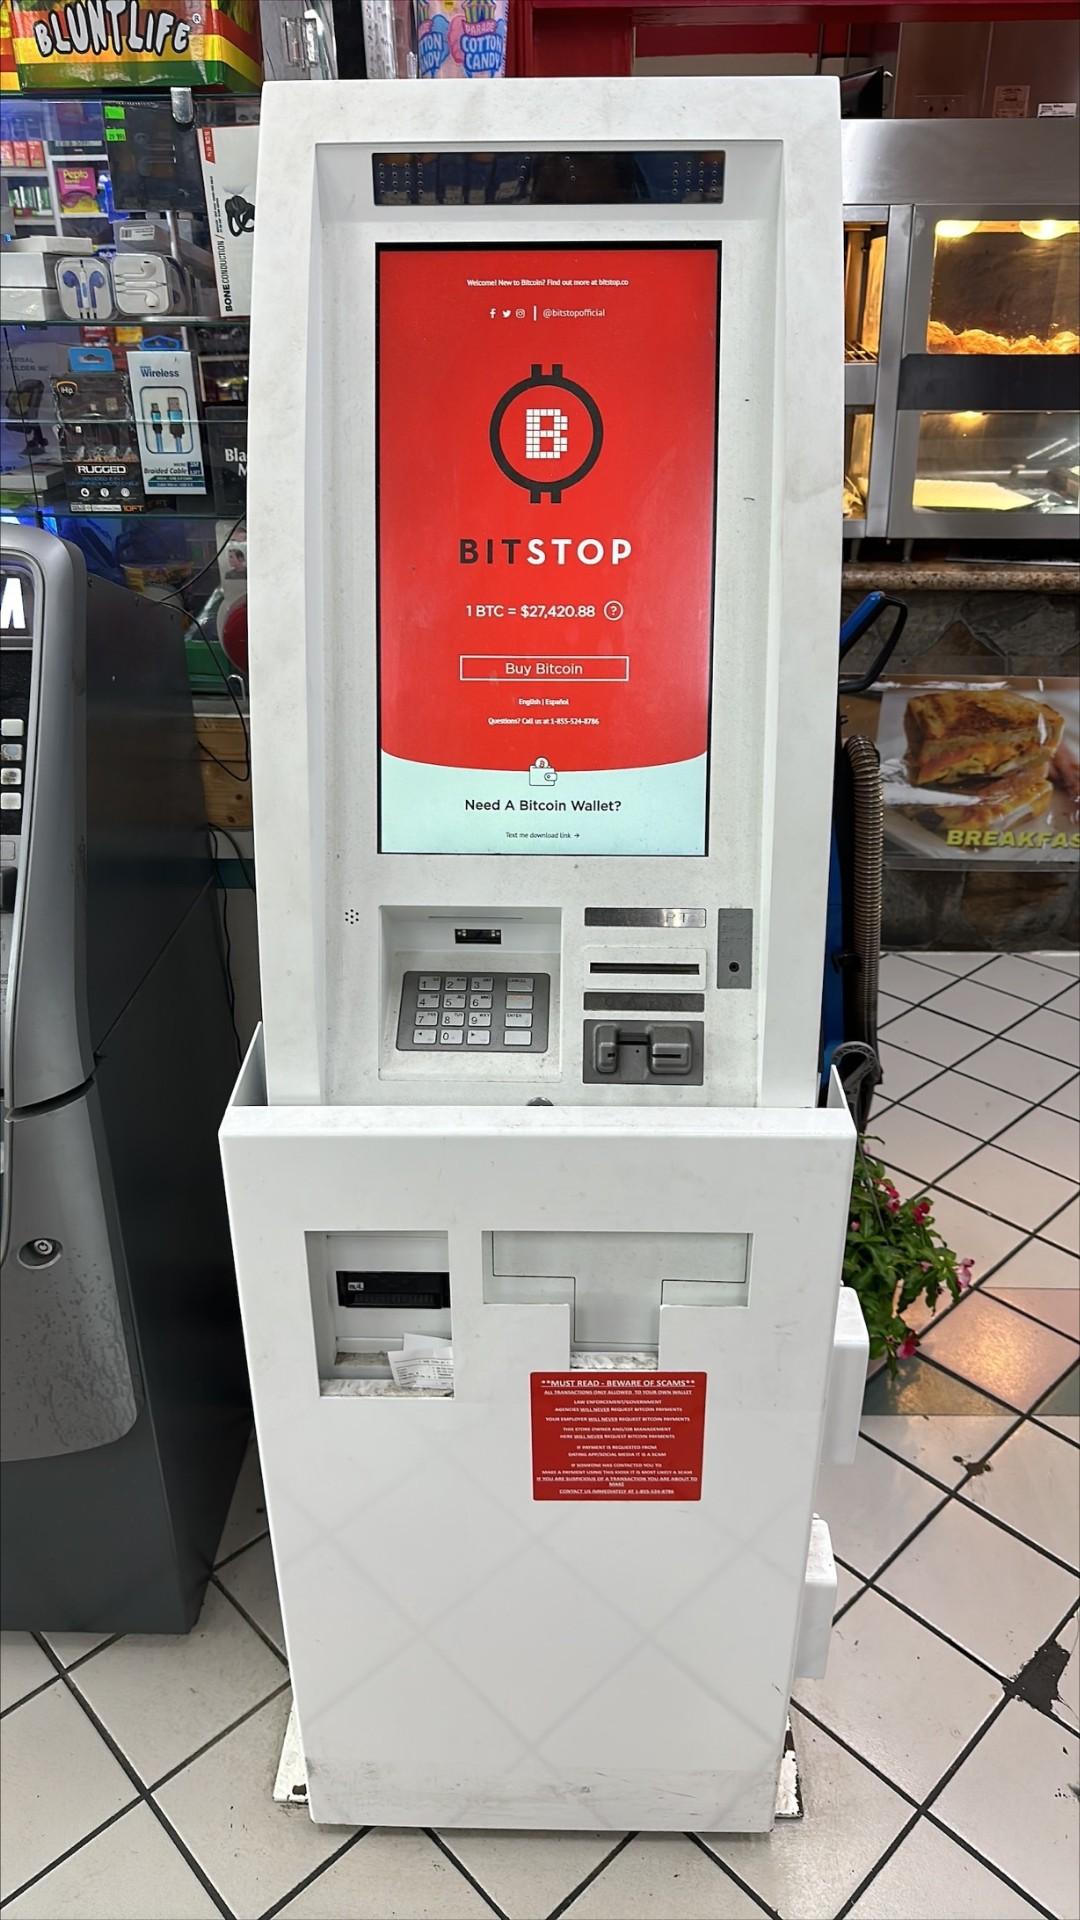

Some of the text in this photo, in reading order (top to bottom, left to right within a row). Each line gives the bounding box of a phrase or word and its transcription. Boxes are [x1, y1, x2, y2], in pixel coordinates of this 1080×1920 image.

[461, 34, 501, 54] COTTON
[465, 52, 500, 71] CANDY
[215, 240, 233, 312] BONE CONDUCTION
[466, 279, 629, 287] Welcome! New to Bitcoin? Find out more at bitstop.co
[543, 308, 605, 319] @bitstopofficial
[140, 366, 180, 378] Wireless
[77, 465, 127, 474] RUGGED
[459, 538, 632, 565] BITSTOP
[466, 605, 472, 617] 1
[476, 605, 504, 617] BTC
[520, 605, 596, 619] $27,420.88
[505, 662, 583, 676] Buy Bitcoin
[518, 698, 569, 706] English Español
[488, 717, 520, 725] Questions?
[522, 717, 533, 725] Call
[535, 717, 542, 725] us
[543, 717, 549, 725] at
[465, 799, 622, 812] Need A Bitcoin Wallet?
[505, 831, 518, 839] Text
[519, 831, 529, 839] me
[530, 831, 559, 839] download
[946, 829, 1080, 849] BREAKFAS
[421, 980, 427, 988] 1
[446, 981, 454, 989] 2
[473, 981, 480, 989] 3
[419, 998, 426, 1006] 4
[445, 999, 452, 1007] 5
[472, 999, 479, 1007] 6
[418, 1015, 424, 1023] 7
[444, 1016, 451, 1024] 8
[471, 1016, 478, 1024] 9
[443, 1032, 450, 1040] 0
[577, 1379, 600, 1387] READ
[606, 1379, 641, 1387] BEWARE
[643, 1379, 655, 1387] OF
